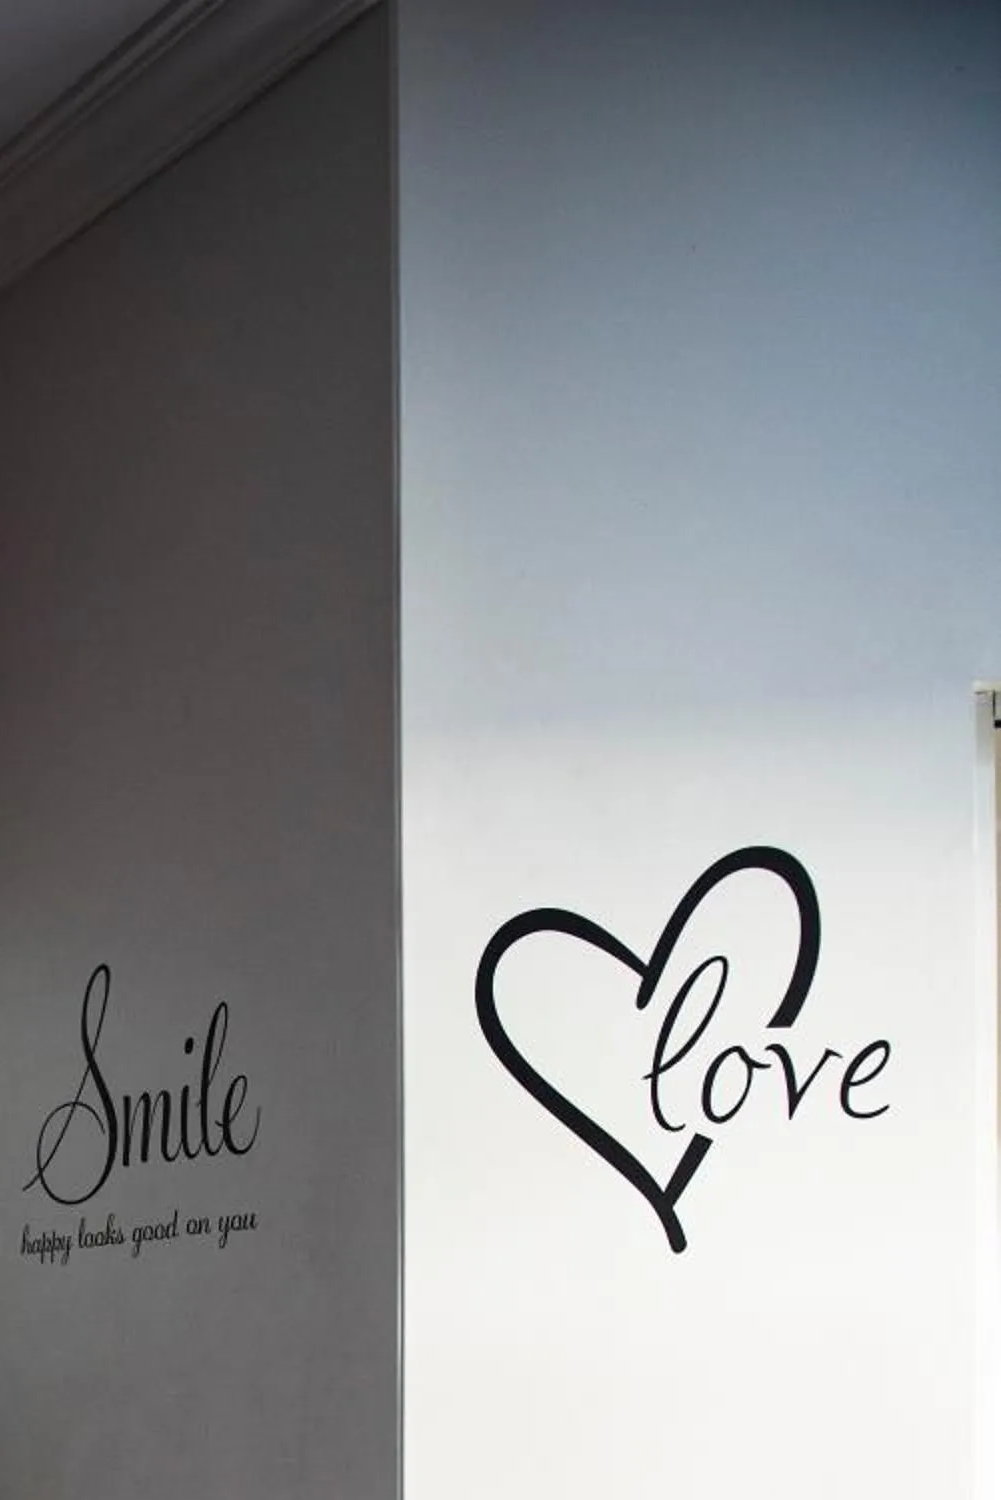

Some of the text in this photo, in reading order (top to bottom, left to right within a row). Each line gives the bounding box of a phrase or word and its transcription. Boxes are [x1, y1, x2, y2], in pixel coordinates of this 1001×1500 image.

[22, 963, 261, 1205] Smile
[642, 955, 892, 1132] love
[20, 1208, 258, 1265] happy looks good on you
